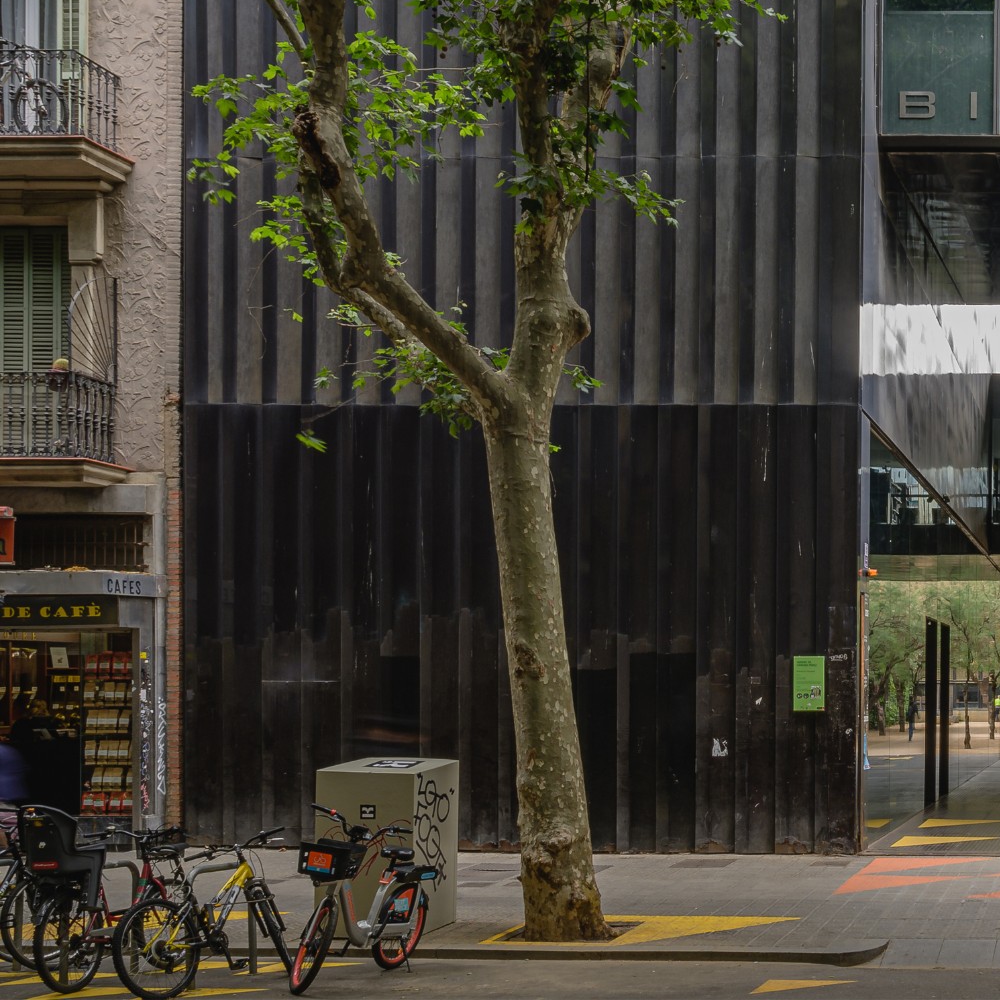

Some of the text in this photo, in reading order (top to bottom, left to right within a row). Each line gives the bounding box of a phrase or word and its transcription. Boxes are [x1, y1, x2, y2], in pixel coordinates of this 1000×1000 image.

[107, 578, 141, 595] CAFES
[2, 602, 102, 618] DE CAFÈ
